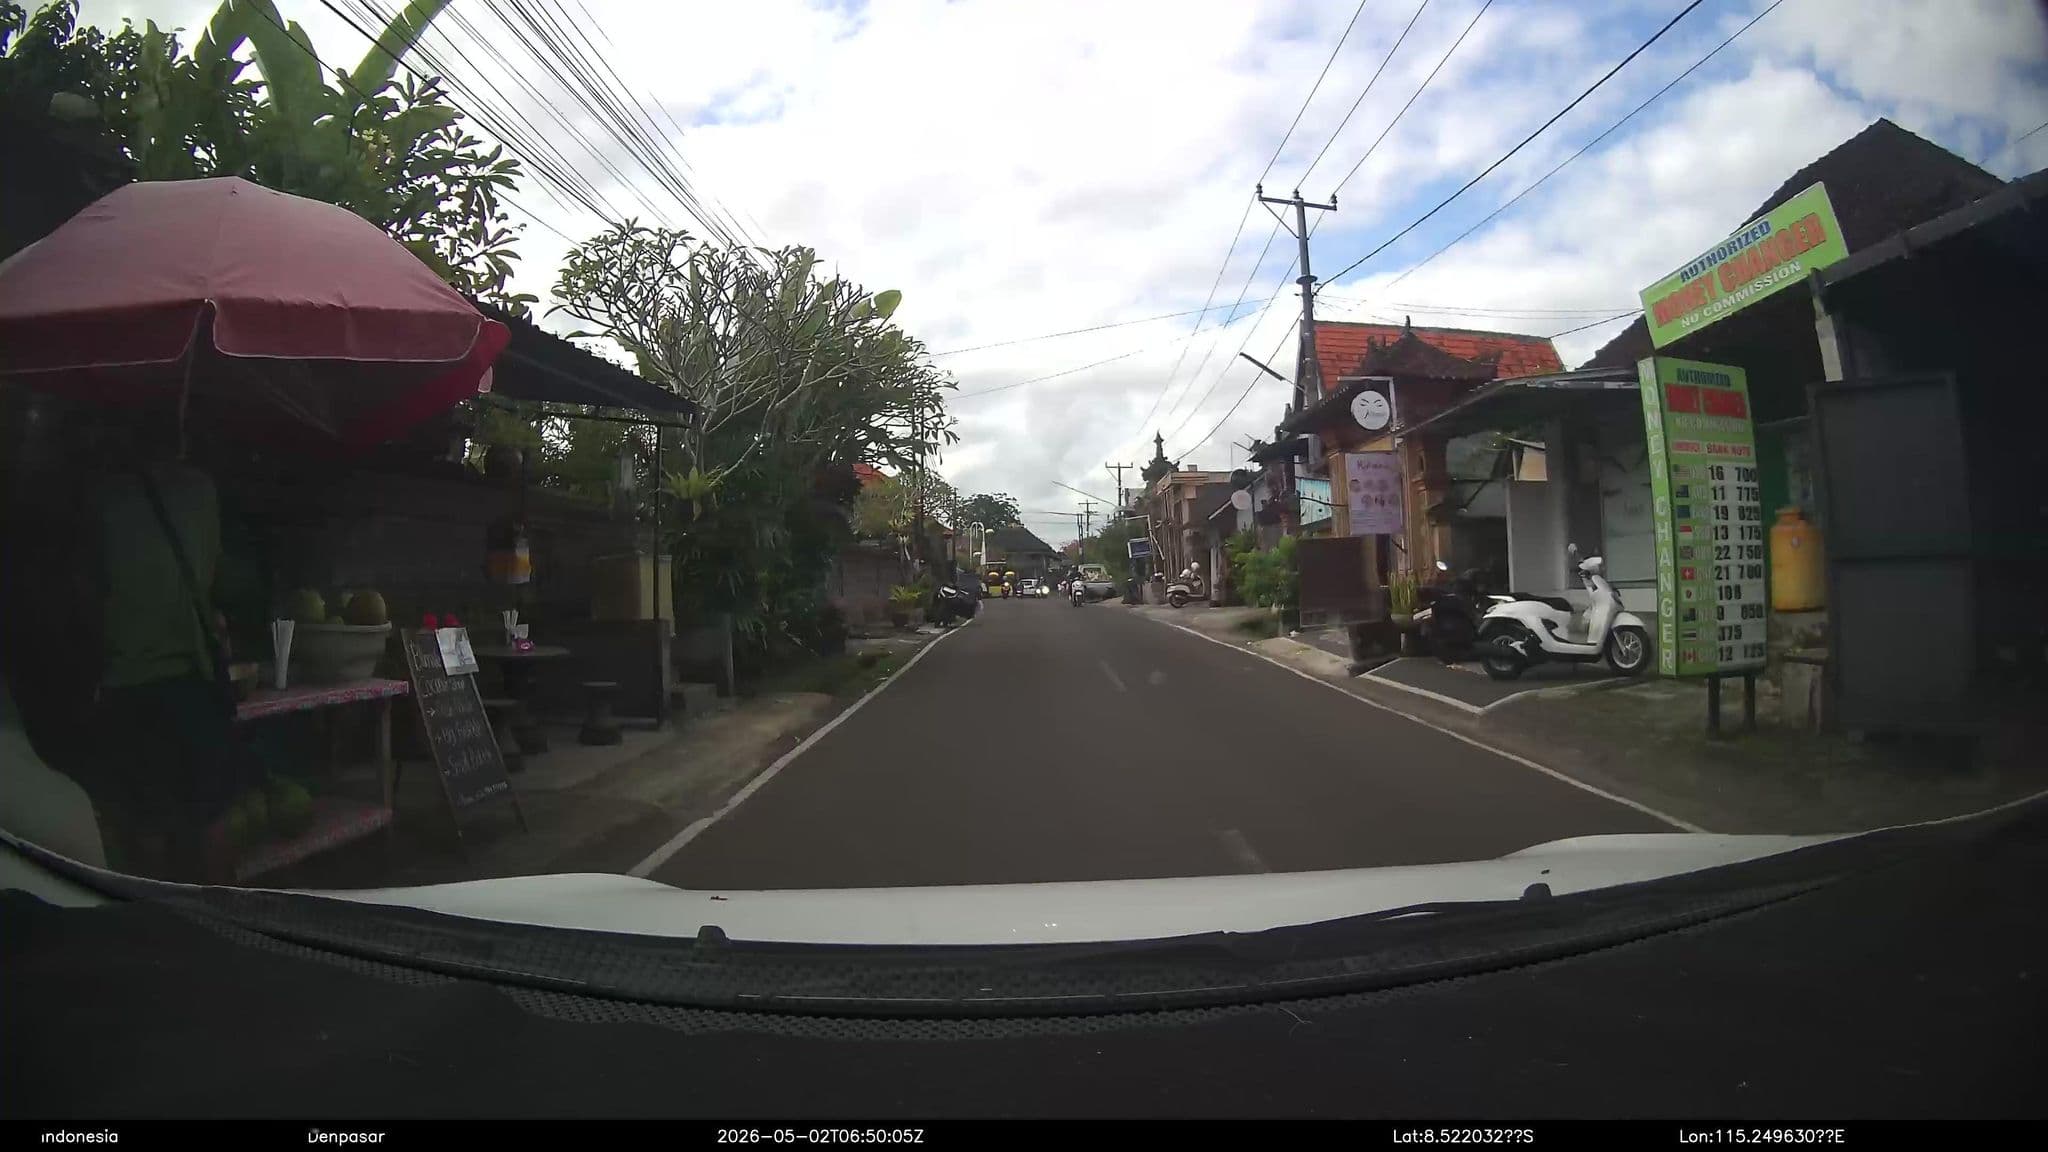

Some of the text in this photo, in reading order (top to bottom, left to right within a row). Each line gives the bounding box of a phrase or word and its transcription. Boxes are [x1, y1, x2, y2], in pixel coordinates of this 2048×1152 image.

[1680, 220, 1772, 283] AUTHORIZED
[1717, 211, 1828, 293] CHANGER
[1680, 261, 1802, 328] NO COMMISSION
[1708, 465, 1724, 481] 16
[1711, 486, 1725, 501] 11
[1736, 486, 1759, 501] 775
[1713, 505, 1728, 521] 19
[1714, 525, 1729, 540] 13
[1739, 525, 1761, 540] 175
[1715, 545, 1731, 560] 22
[1737, 545, 1761, 559] 750
[1715, 565, 1730, 580] 21
[1655, 496, 1674, 669] CHANGER
[1719, 646, 1733, 661] 12
